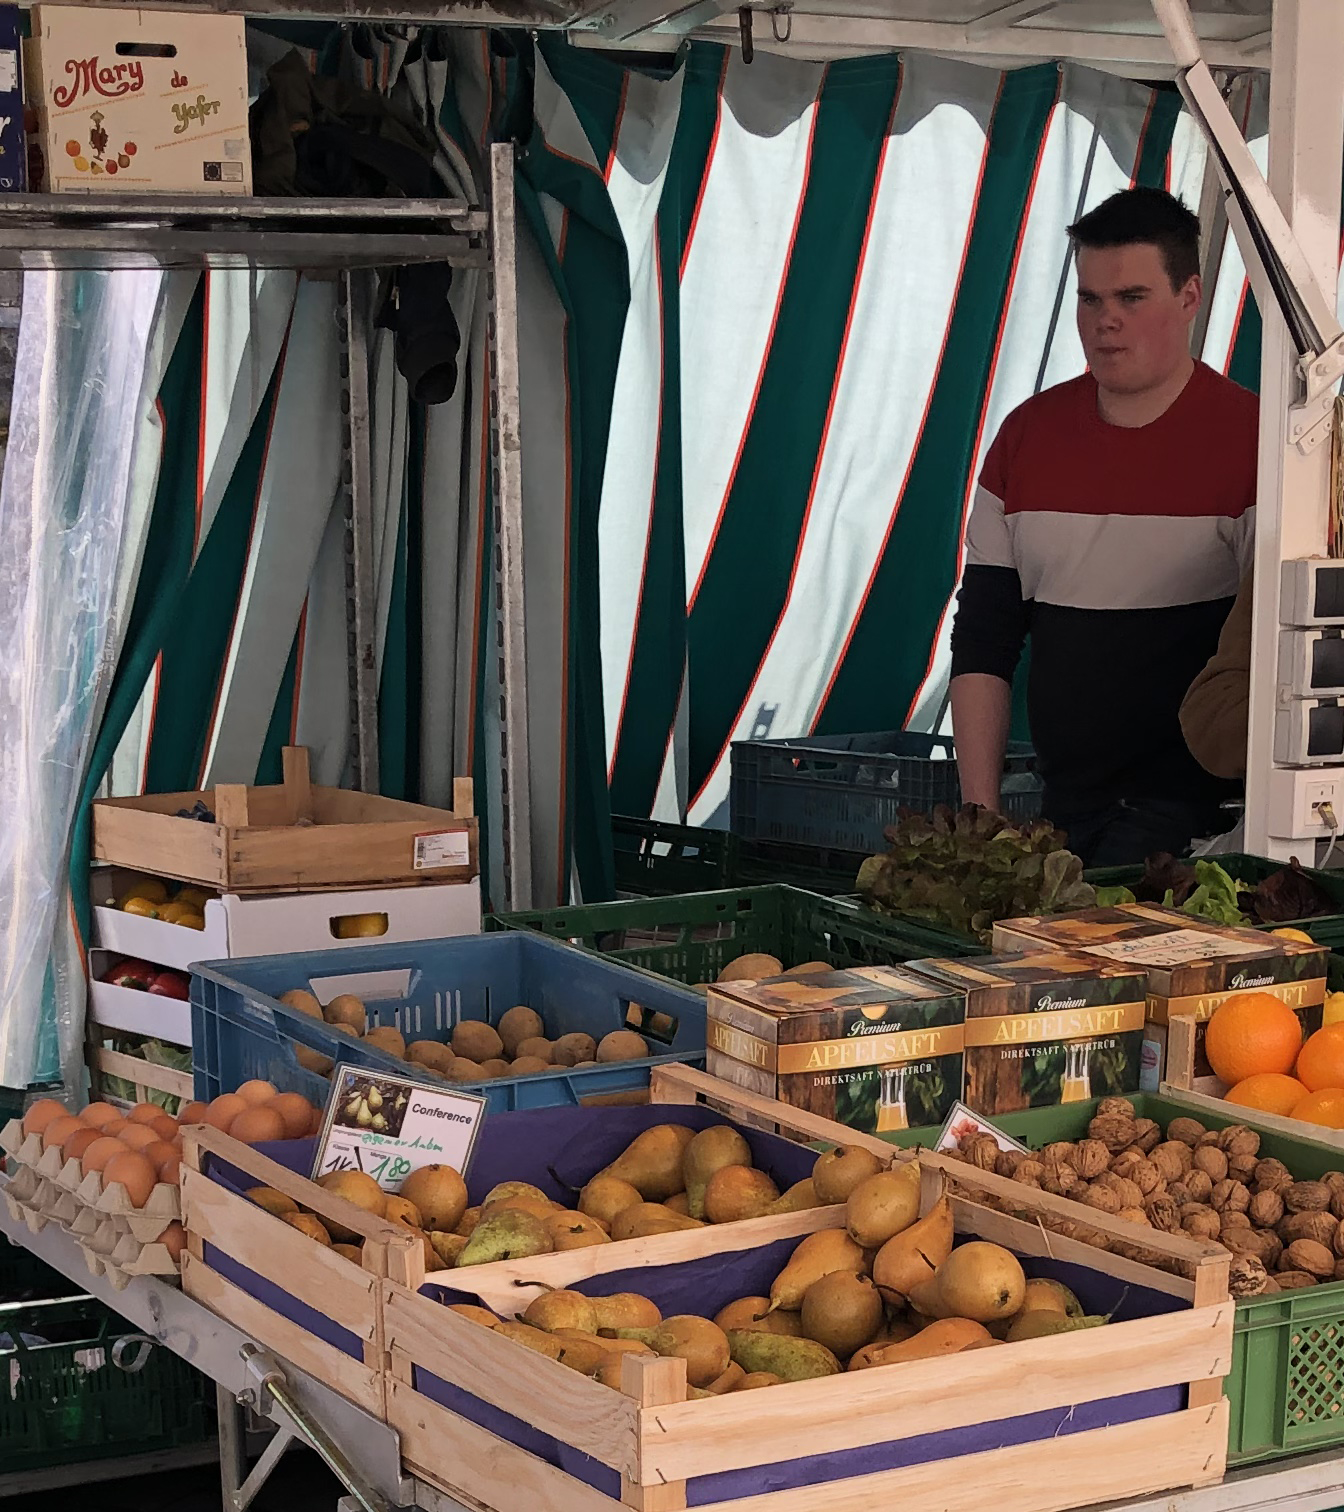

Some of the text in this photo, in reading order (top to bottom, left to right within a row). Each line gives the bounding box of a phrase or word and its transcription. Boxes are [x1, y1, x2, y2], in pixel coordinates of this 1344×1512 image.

[53, 55, 144, 108] Mary
[170, 69, 189, 88] de
[171, 94, 221, 135] Yafer
[1228, 974, 1275, 990] Premium
[1034, 995, 1087, 1012] Premium
[846, 1020, 901, 1037] Premium
[993, 1009, 1125, 1042] APFELSAFT
[712, 1025, 769, 1066] APFELSAFT
[806, 1032, 941, 1069] APFELSAFT
[999, 1038, 1116, 1060] DIREKTSAFT NATURTRÜB
[813, 1063, 932, 1087] DIREKTSAFT NATURTRÜB
[412, 1103, 473, 1125] Conference
